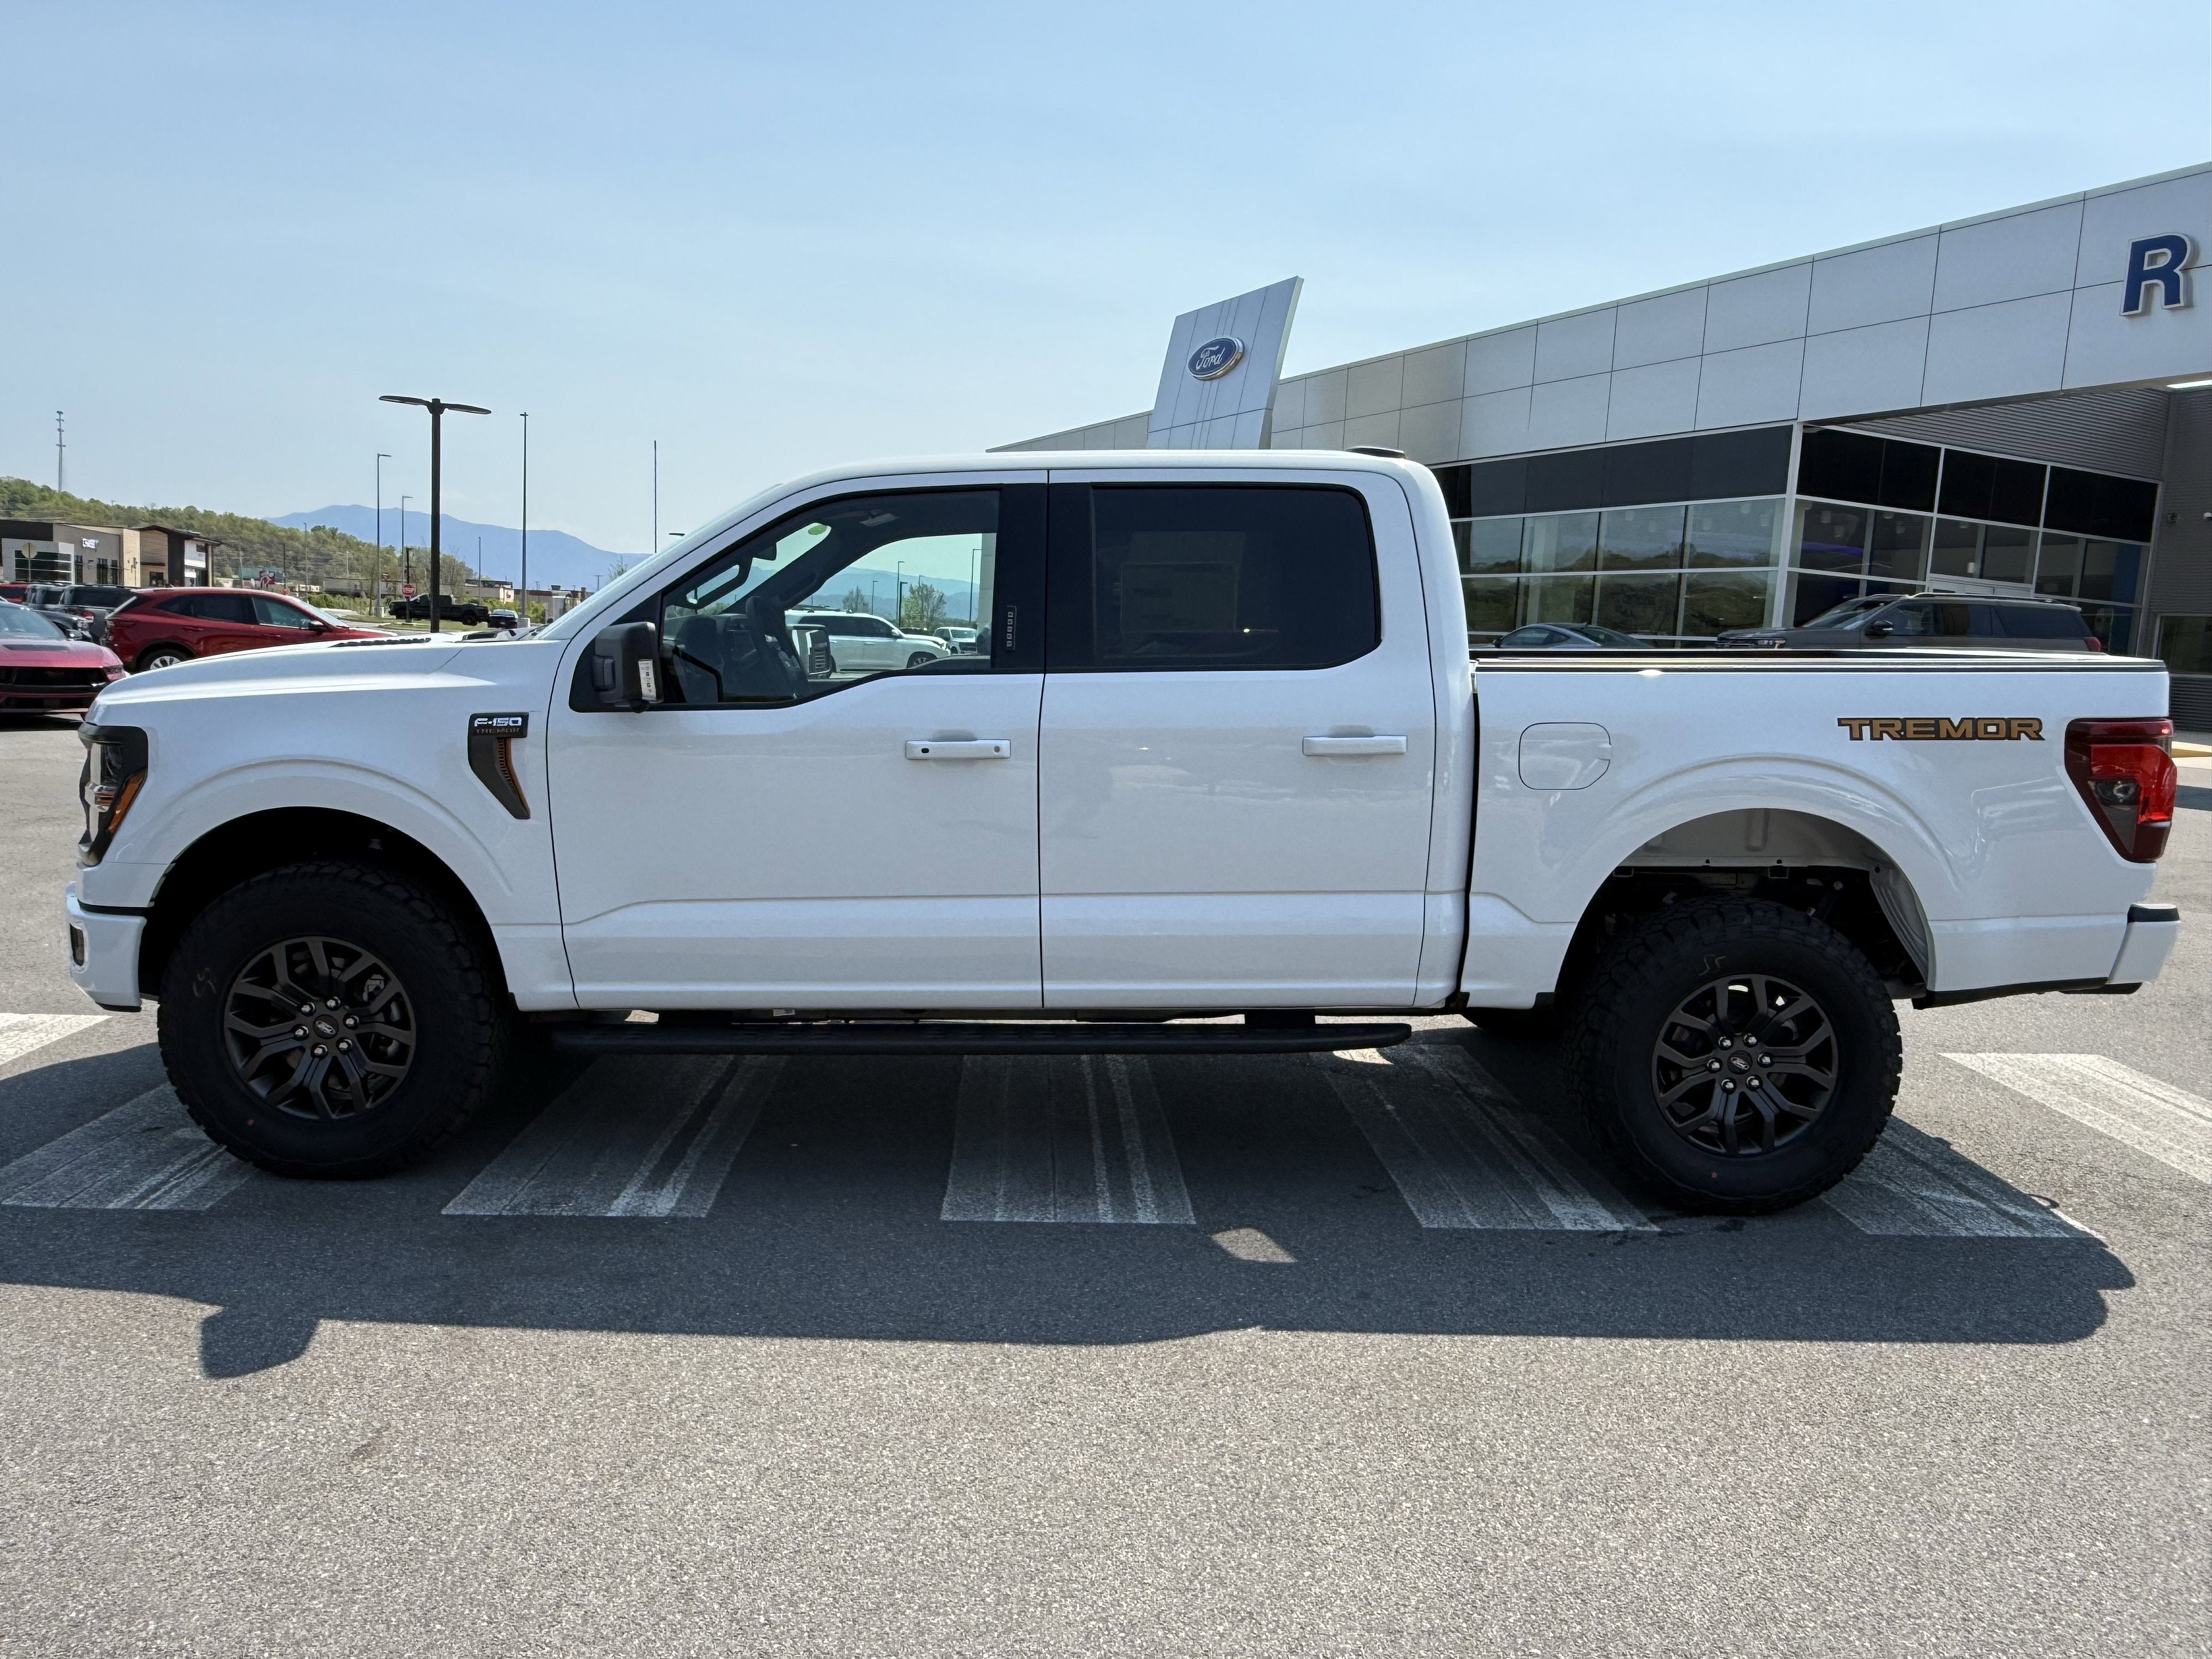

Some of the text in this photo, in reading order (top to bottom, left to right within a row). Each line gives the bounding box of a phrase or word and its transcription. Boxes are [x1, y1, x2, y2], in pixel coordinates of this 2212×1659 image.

[2120, 233, 2190, 315] R
[1196, 346, 1226, 370] Ford
[474, 717, 522, 727] F-150
[1837, 718, 2045, 741] TREMOR
